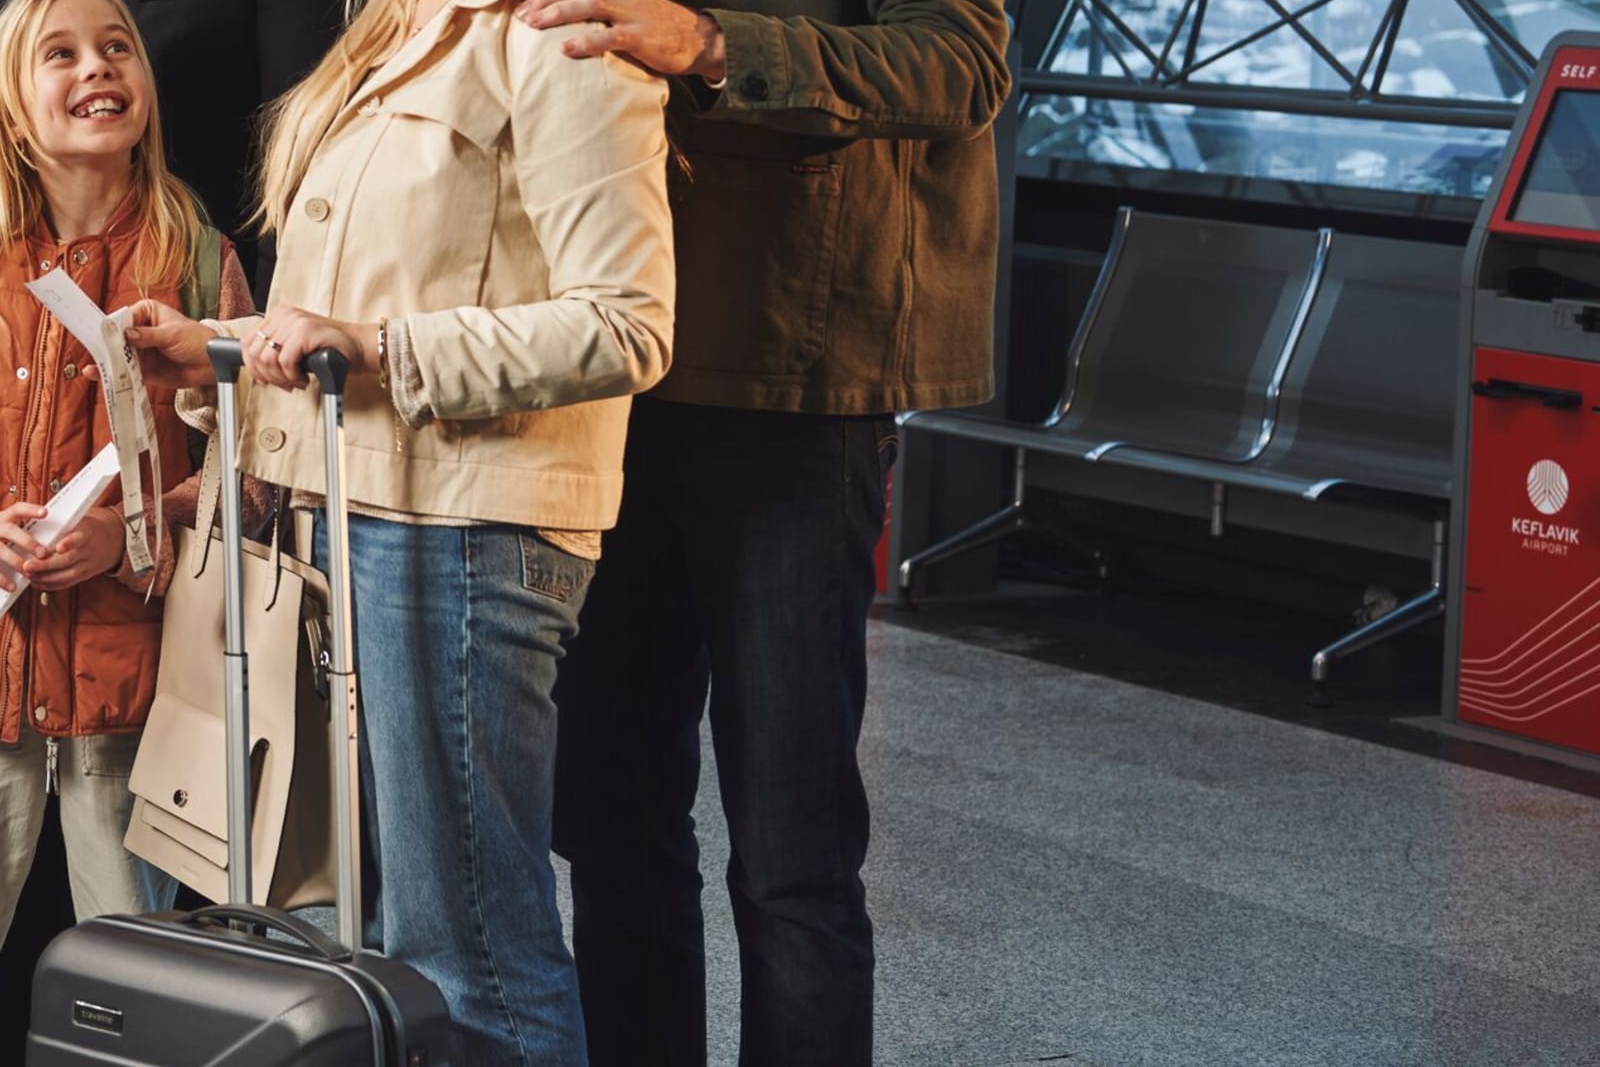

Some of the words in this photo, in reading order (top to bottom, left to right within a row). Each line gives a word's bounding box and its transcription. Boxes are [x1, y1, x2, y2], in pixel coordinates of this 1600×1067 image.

[1560, 63, 1597, 79] SELF
[1512, 517, 1579, 545] KEFLAVIK
[1522, 539, 1568, 555] AIRPORT
